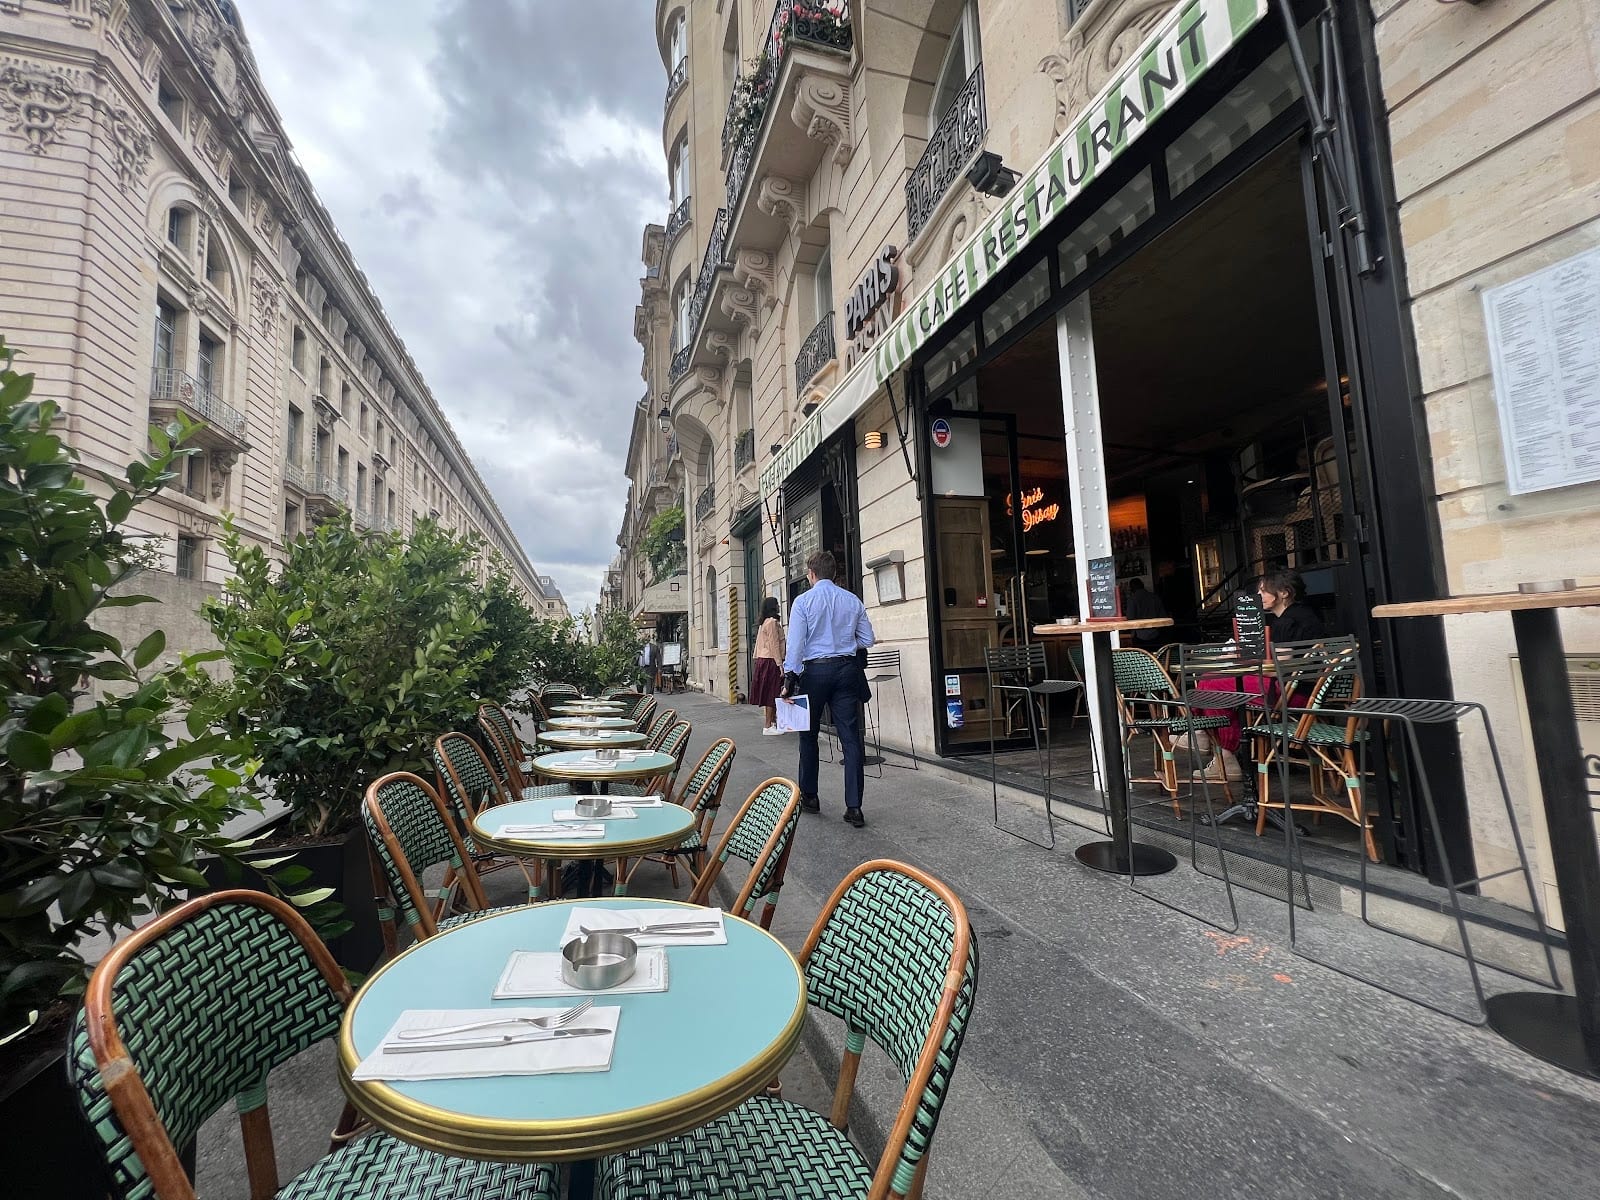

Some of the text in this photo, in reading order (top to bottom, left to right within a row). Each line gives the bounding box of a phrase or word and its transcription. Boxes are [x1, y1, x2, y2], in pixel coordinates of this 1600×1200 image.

[984, 11, 1208, 268] RESTAURANT
[844, 244, 898, 340] PARIS
[1022, 503, 1060, 532] Orsay
